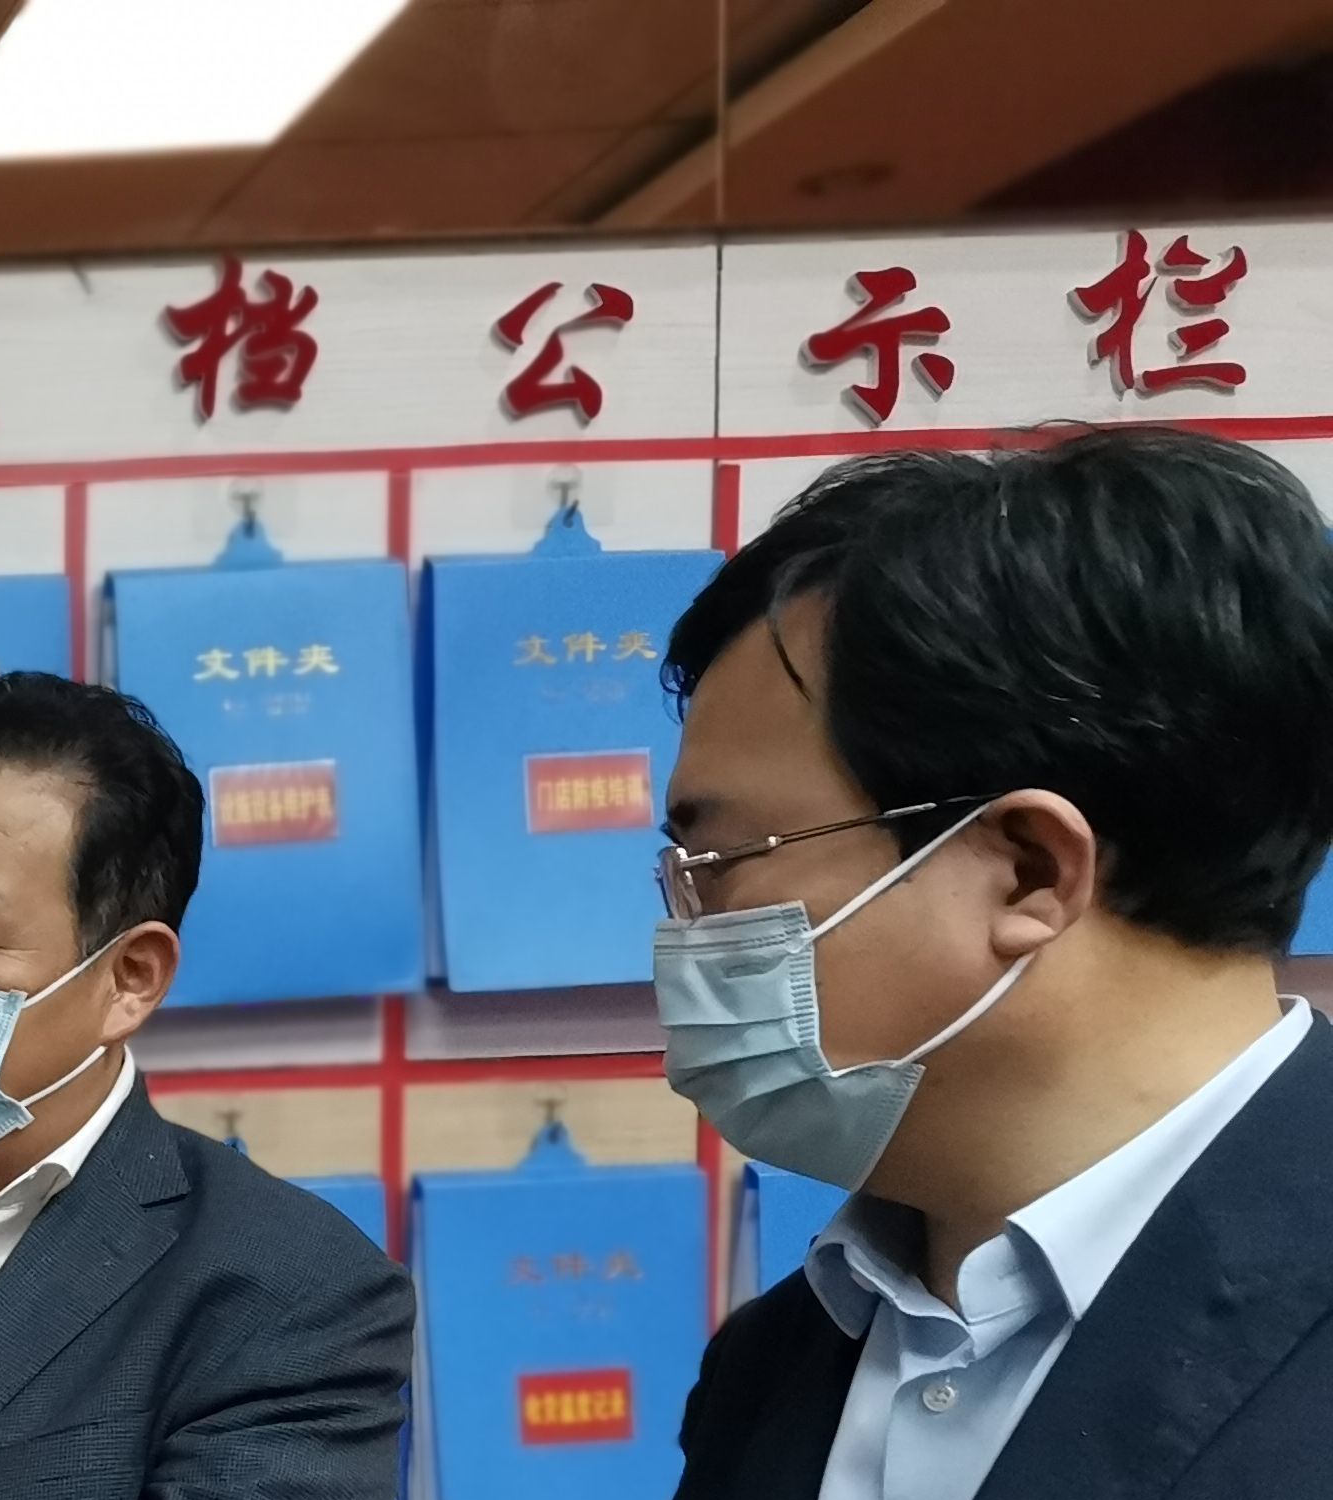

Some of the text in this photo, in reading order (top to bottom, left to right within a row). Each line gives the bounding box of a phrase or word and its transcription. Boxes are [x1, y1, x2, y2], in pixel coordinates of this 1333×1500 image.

[192, 644, 340, 680] 文件夹
[512, 630, 658, 667] 文件夹
